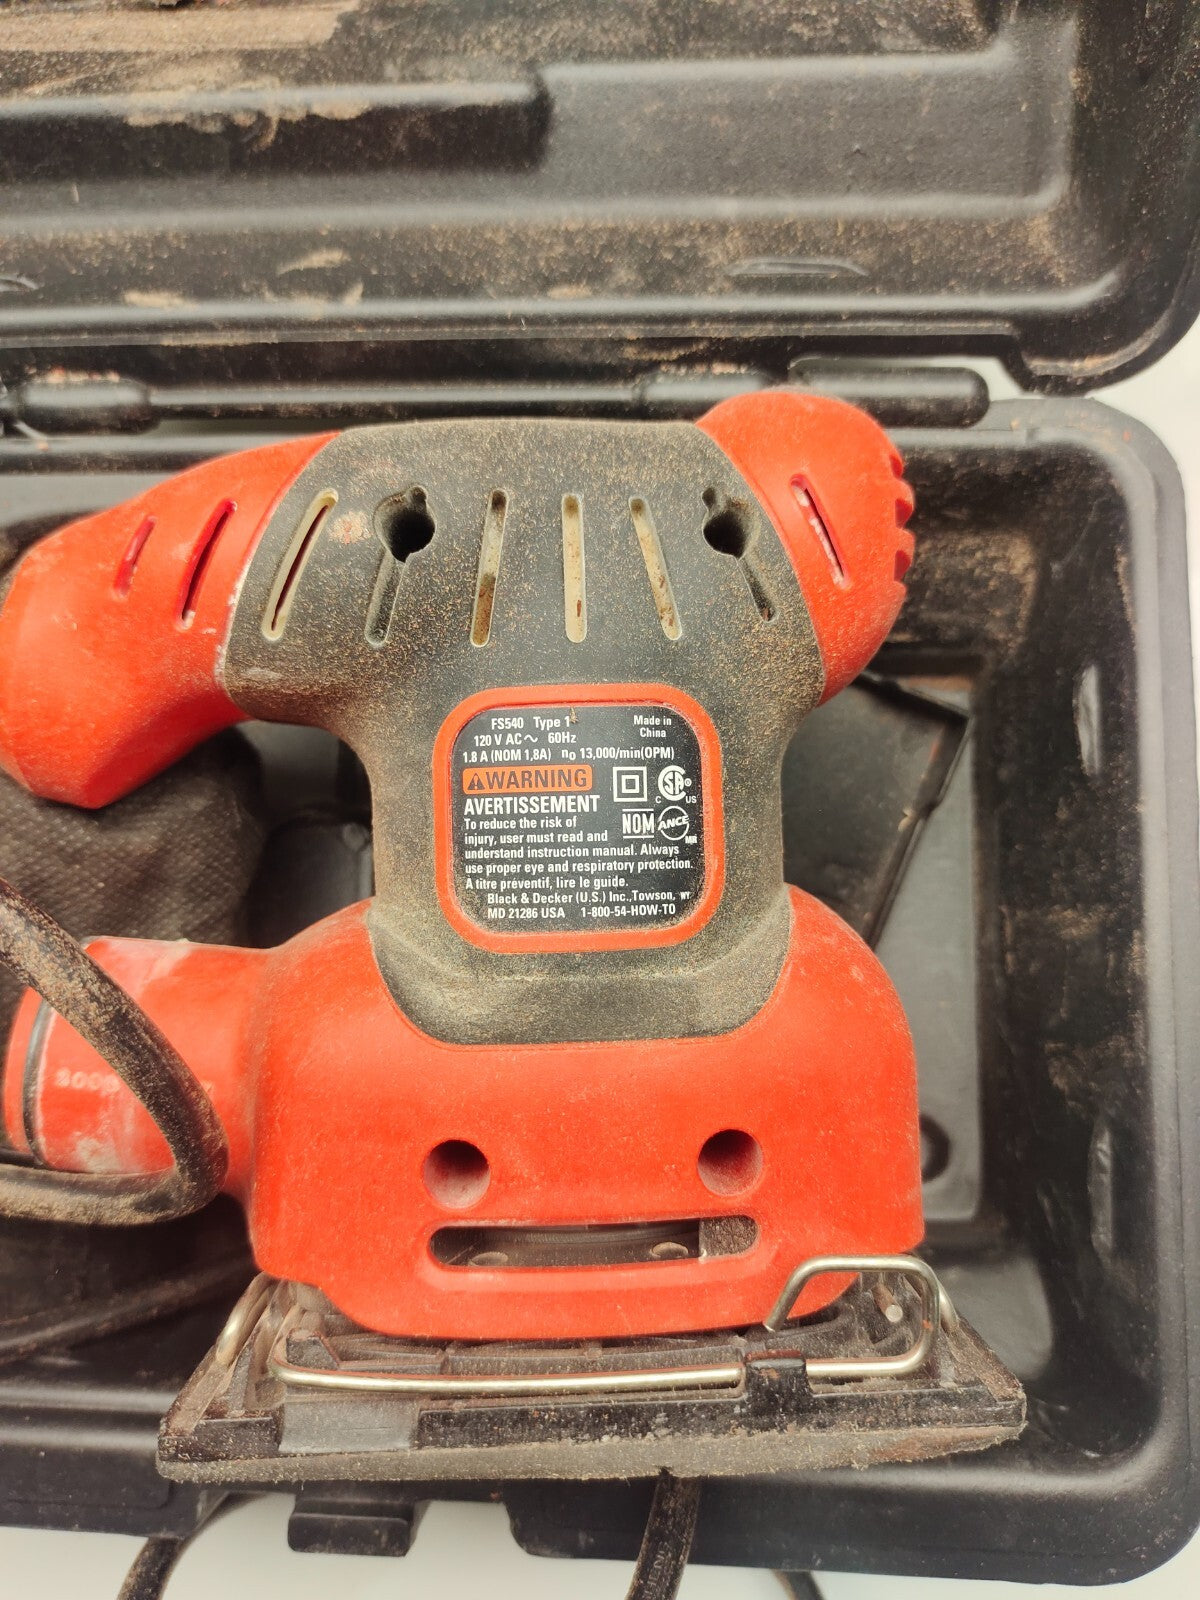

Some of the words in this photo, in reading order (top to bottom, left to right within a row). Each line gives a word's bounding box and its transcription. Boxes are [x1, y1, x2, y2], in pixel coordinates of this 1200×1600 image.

[491, 717, 523, 730] FS540
[533, 716, 561, 731] Type
[564, 716, 570, 727] 1
[633, 715, 661, 726] Made
[663, 715, 672, 726] in
[474, 735, 492, 747] 120
[494, 734, 503, 745] V
[548, 731, 577, 744] 60Hz
[639, 727, 667, 738] China
[463, 751, 477, 763] 1.8
[480, 750, 488, 762] A
[491, 749, 521, 763] (NOM
[524, 748, 552, 762] 1,8A)
[580, 746, 675, 760] 13,000/min(OPM)
[485, 769, 587, 790] WARNING
[464, 795, 600, 815] AVERTISSEMENT
[685, 795, 697, 804] US
[464, 818, 477, 830] To
[479, 817, 516, 830] reduce
[519, 817, 537, 828] the
[540, 816, 562, 828] risk
[565, 815, 578, 828] of
[622, 813, 655, 834] NOM
[657, 814, 690, 831] ANCE
[465, 833, 497, 847] injury,
[500, 834, 524, 844] user
[526, 832, 554, 843] must
[557, 830, 583, 842] read
[587, 830, 608, 842] and
[465, 846, 524, 859] understand
[527, 846, 589, 858] instruction
[592, 844, 638, 857] manual.
[640, 844, 680, 857] Always
[465, 864, 483, 874] use
[486, 864, 522, 876] proper
[524, 863, 544, 875] eye
[547, 860, 569, 872] and
[572, 860, 635, 875] respiratory
[638, 858, 693, 873] protection.
[476, 878, 497, 889] titre
[500, 877, 553, 892] préventif,
[556, 876, 576, 888] lire
[579, 876, 590, 888] le
[594, 875, 629, 889] guide.
[487, 893, 518, 904] Black
[521, 892, 530, 904] &
[532, 892, 573, 904] Decker
[575, 891, 606, 905] (U.S.)
[488, 907, 506, 919] MD
[508, 907, 538, 919] 21286
[541, 907, 566, 918] USA
[580, 903, 676, 918] 1-800-54-HOW-TO
